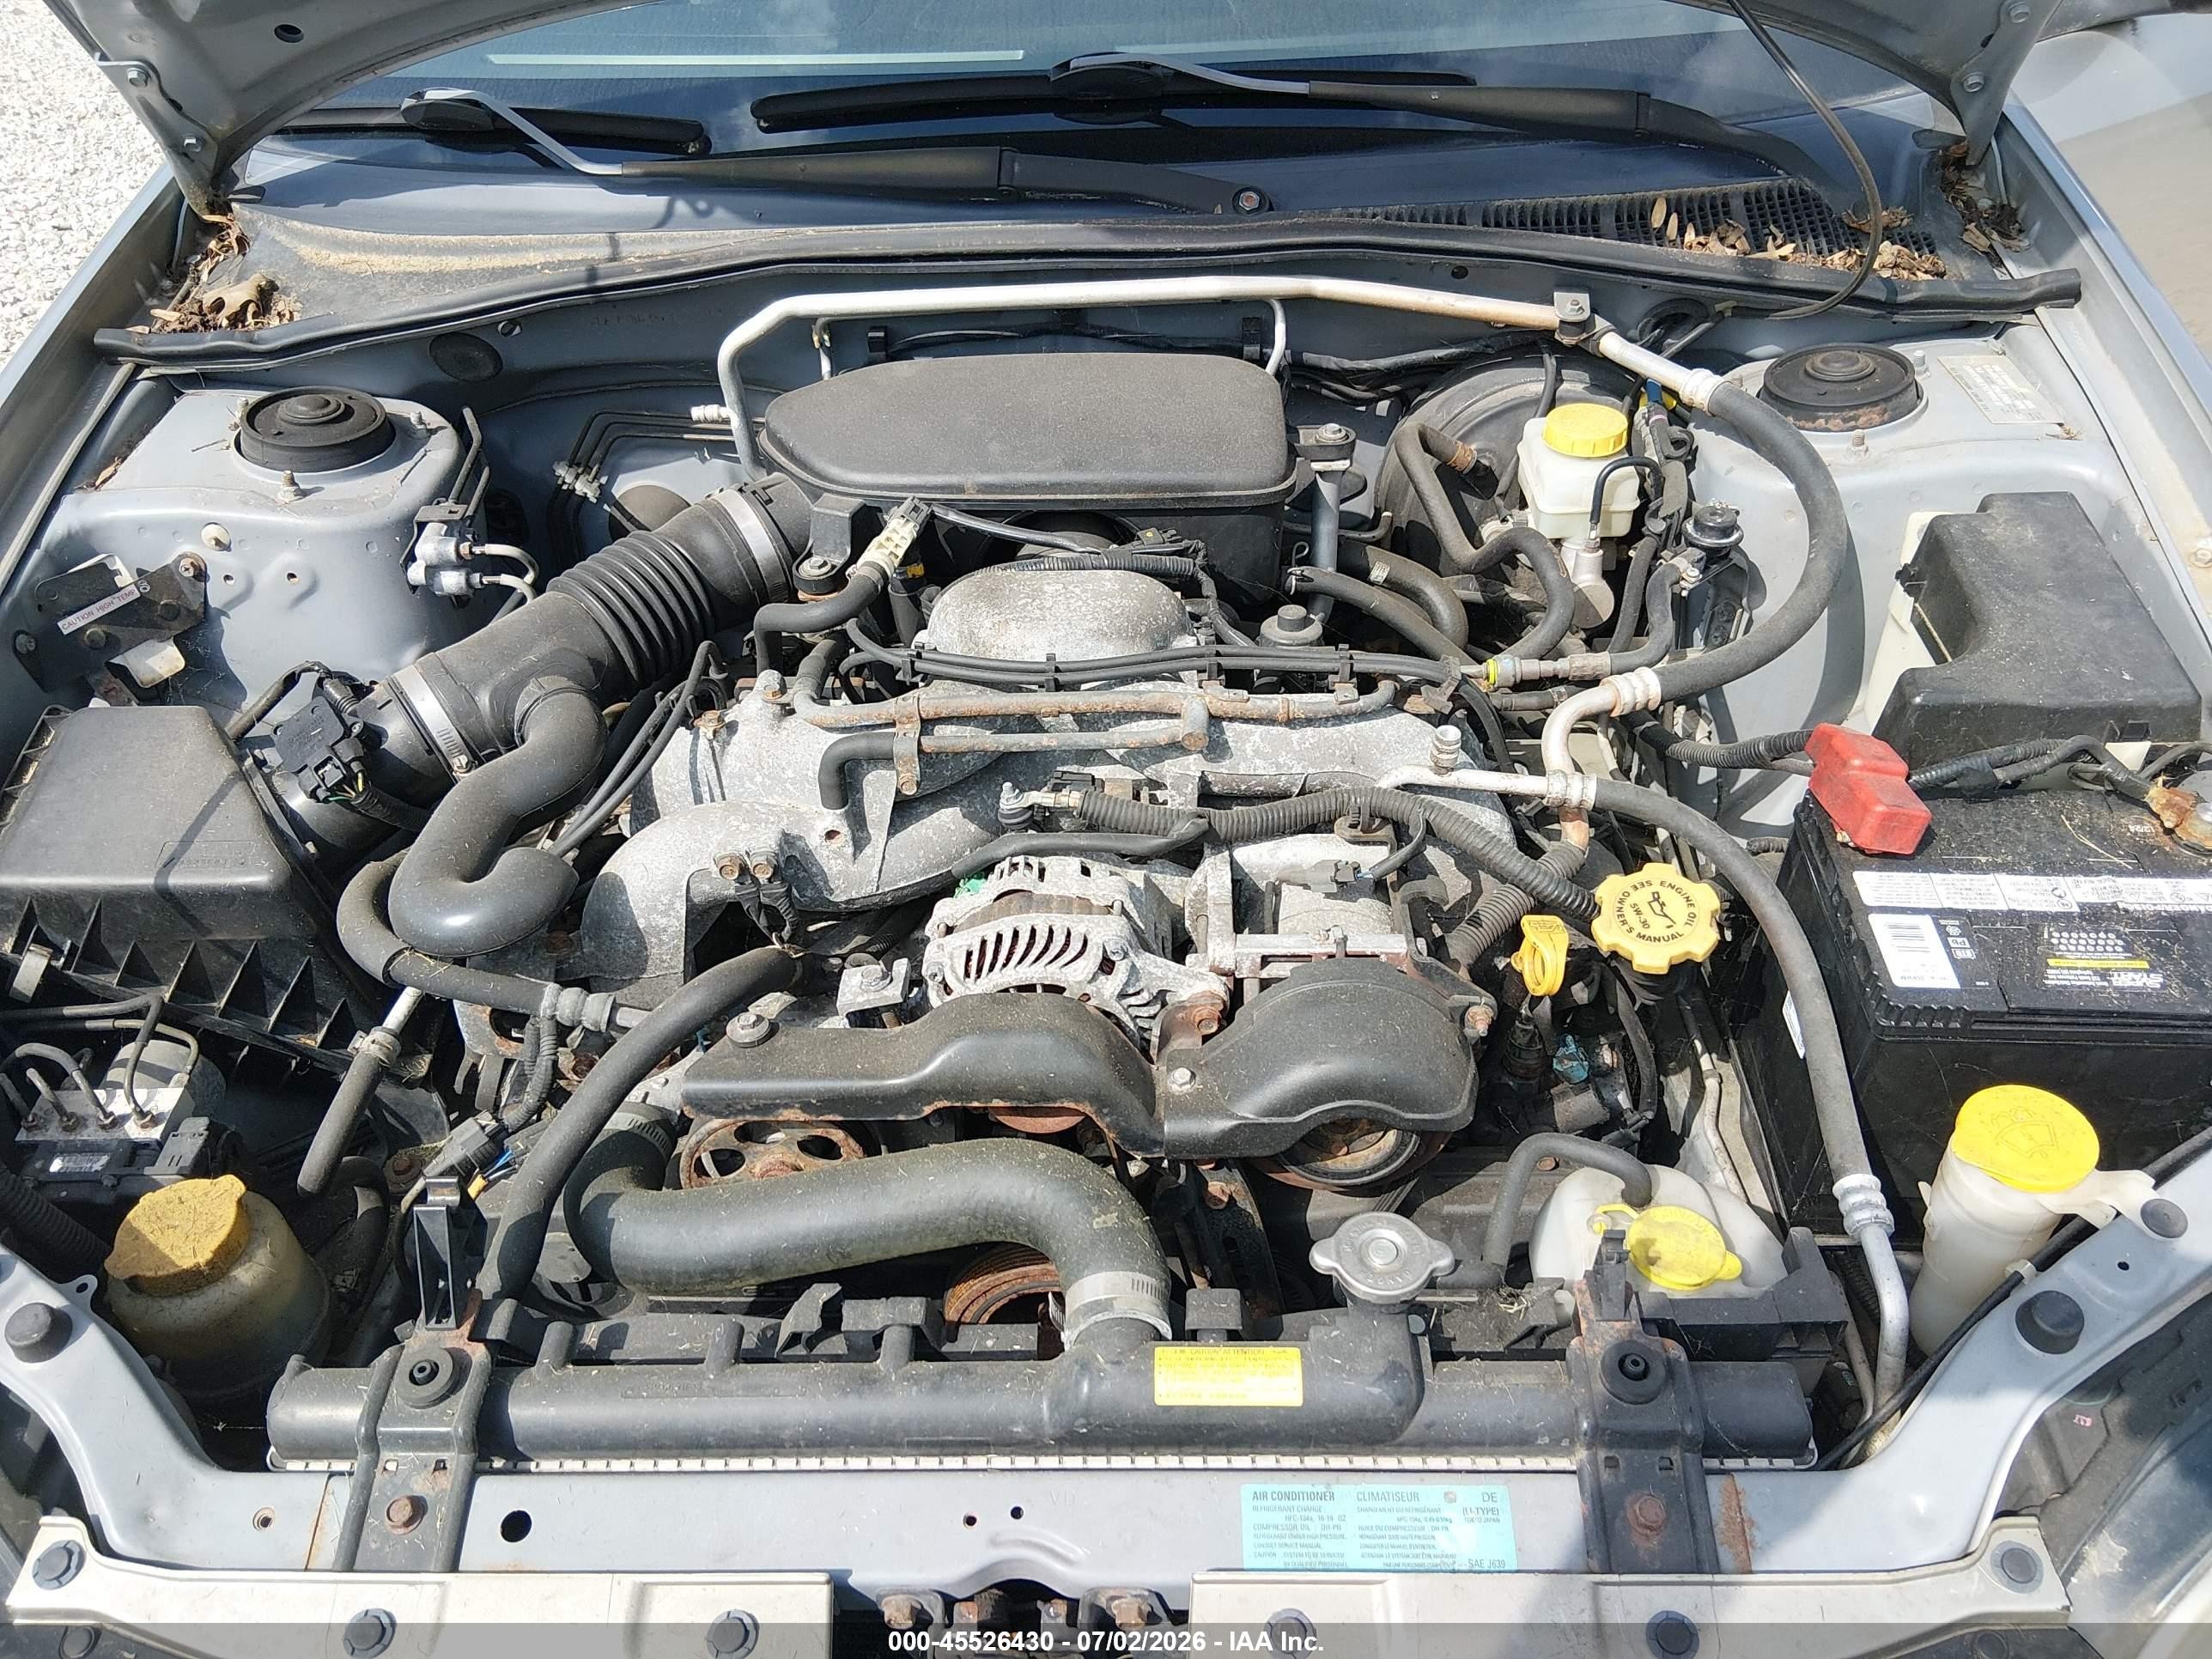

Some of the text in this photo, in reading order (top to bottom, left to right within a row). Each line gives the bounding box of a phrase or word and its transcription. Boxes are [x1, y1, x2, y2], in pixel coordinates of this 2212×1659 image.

[62, 589, 136, 630] CAUTION HIGH TEMP
[1616, 880, 1684, 943] SEE OWNER'S MANUAL
[1659, 880, 1697, 927] ENGINE OIL
[1630, 902, 1650, 930] 5W-30
[1252, 1491, 1335, 1502] AIR CONDITIONER
[1357, 1491, 1419, 1503] CLIMATISEUR
[1481, 1492, 1498, 1503] DE
[1468, 1559, 1506, 1569] SAE J639
